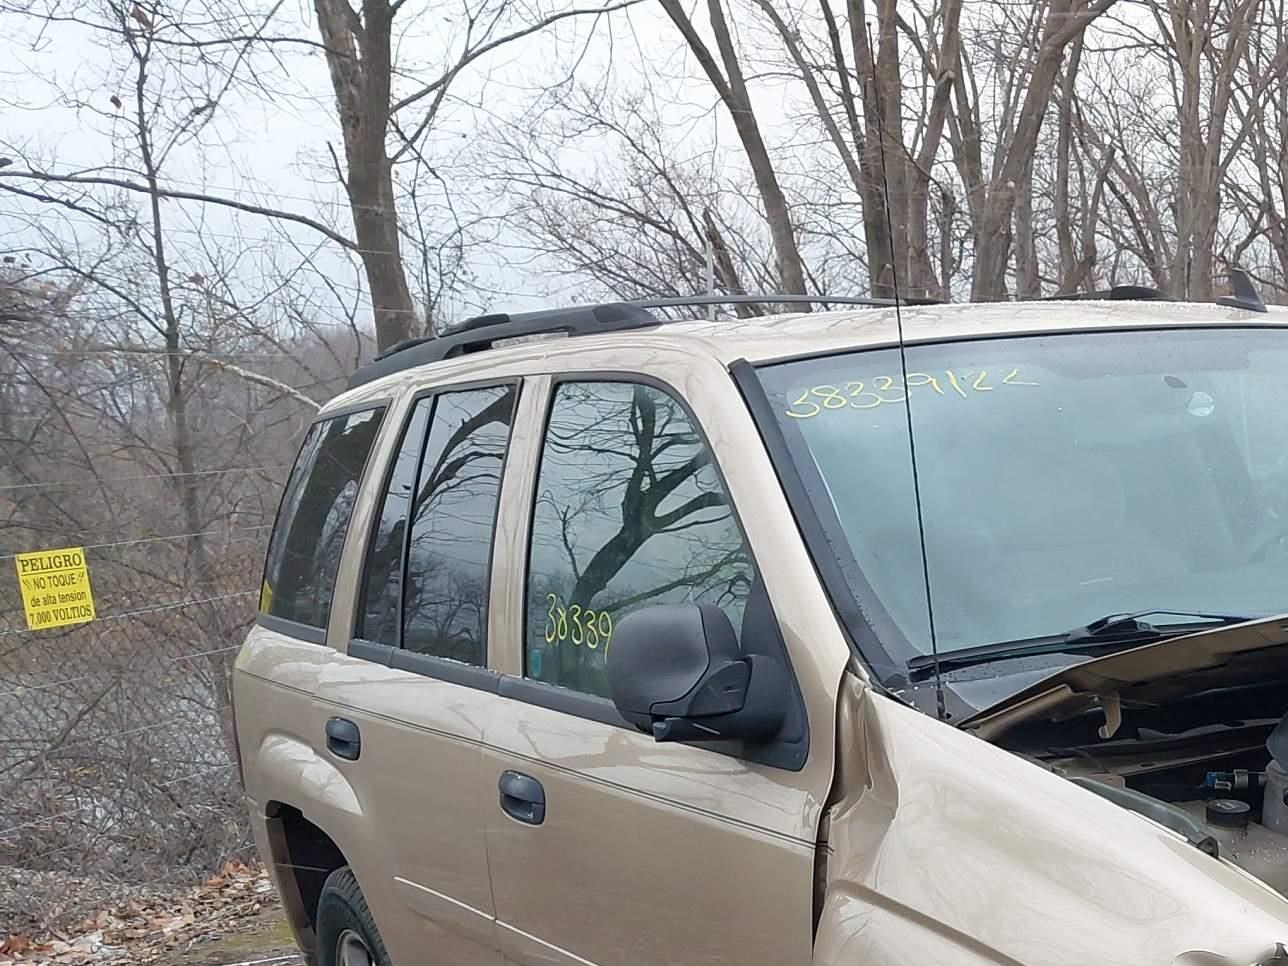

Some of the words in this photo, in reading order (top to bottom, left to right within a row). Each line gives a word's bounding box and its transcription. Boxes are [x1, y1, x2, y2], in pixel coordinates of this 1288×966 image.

[19, 553, 82, 573] PELIGRO
[33, 576, 46, 590] NO
[47, 573, 77, 588] TOQUE
[30, 596, 41, 608] de
[43, 594, 57, 606] alta
[58, 591, 87, 604] tension
[29, 611, 52, 626] 7.000
[52, 604, 92, 621] VOLTIOS
